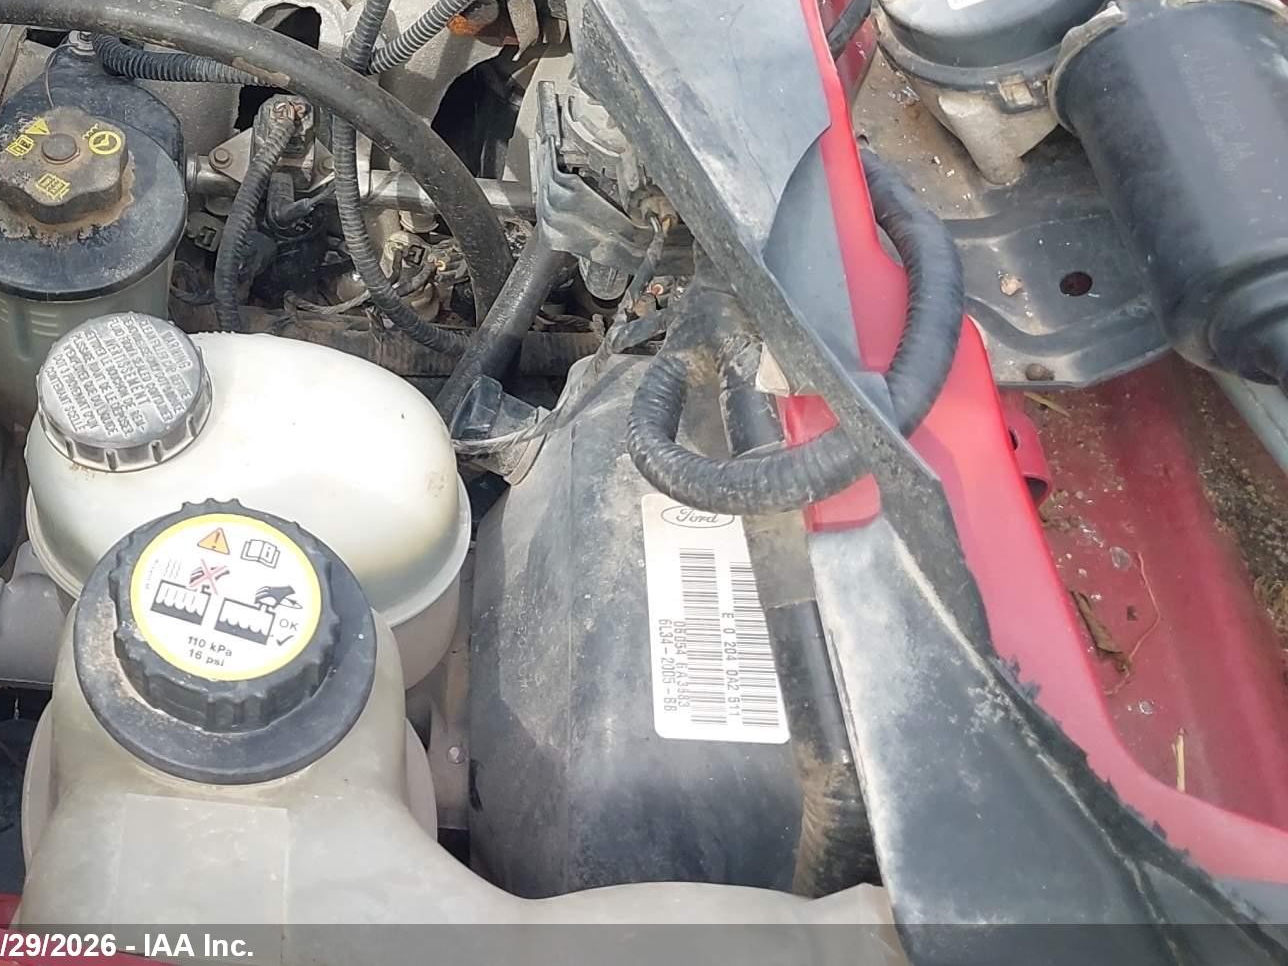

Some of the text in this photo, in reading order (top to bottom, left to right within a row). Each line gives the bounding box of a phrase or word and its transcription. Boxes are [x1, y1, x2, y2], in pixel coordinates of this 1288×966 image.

[675, 509, 718, 523] Ford
[279, 618, 299, 631] OK
[187, 636, 233, 657] 110 kPa
[188, 649, 225, 667] 16 psi
